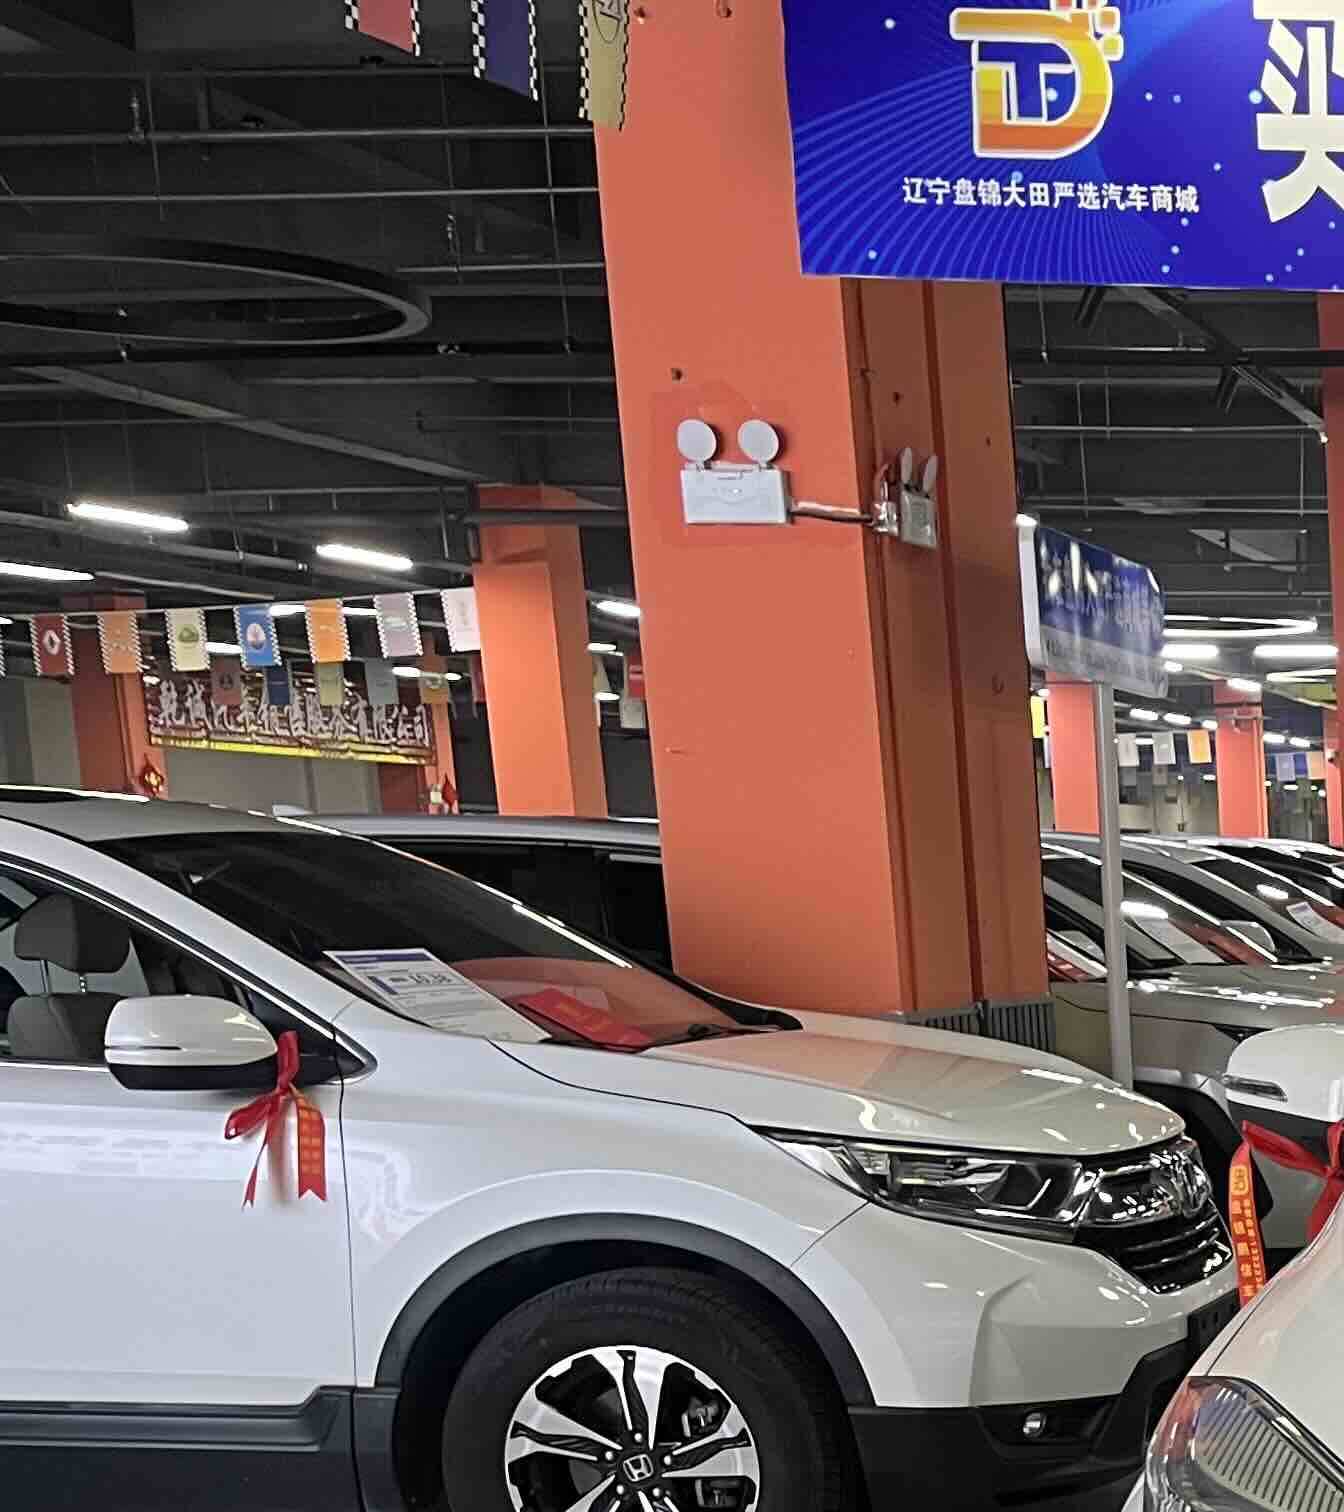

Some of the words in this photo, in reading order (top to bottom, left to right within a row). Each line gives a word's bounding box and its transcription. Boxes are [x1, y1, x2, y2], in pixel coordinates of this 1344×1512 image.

[902, 176, 1200, 213] 辽宁盘锦大田严选汽车商城
